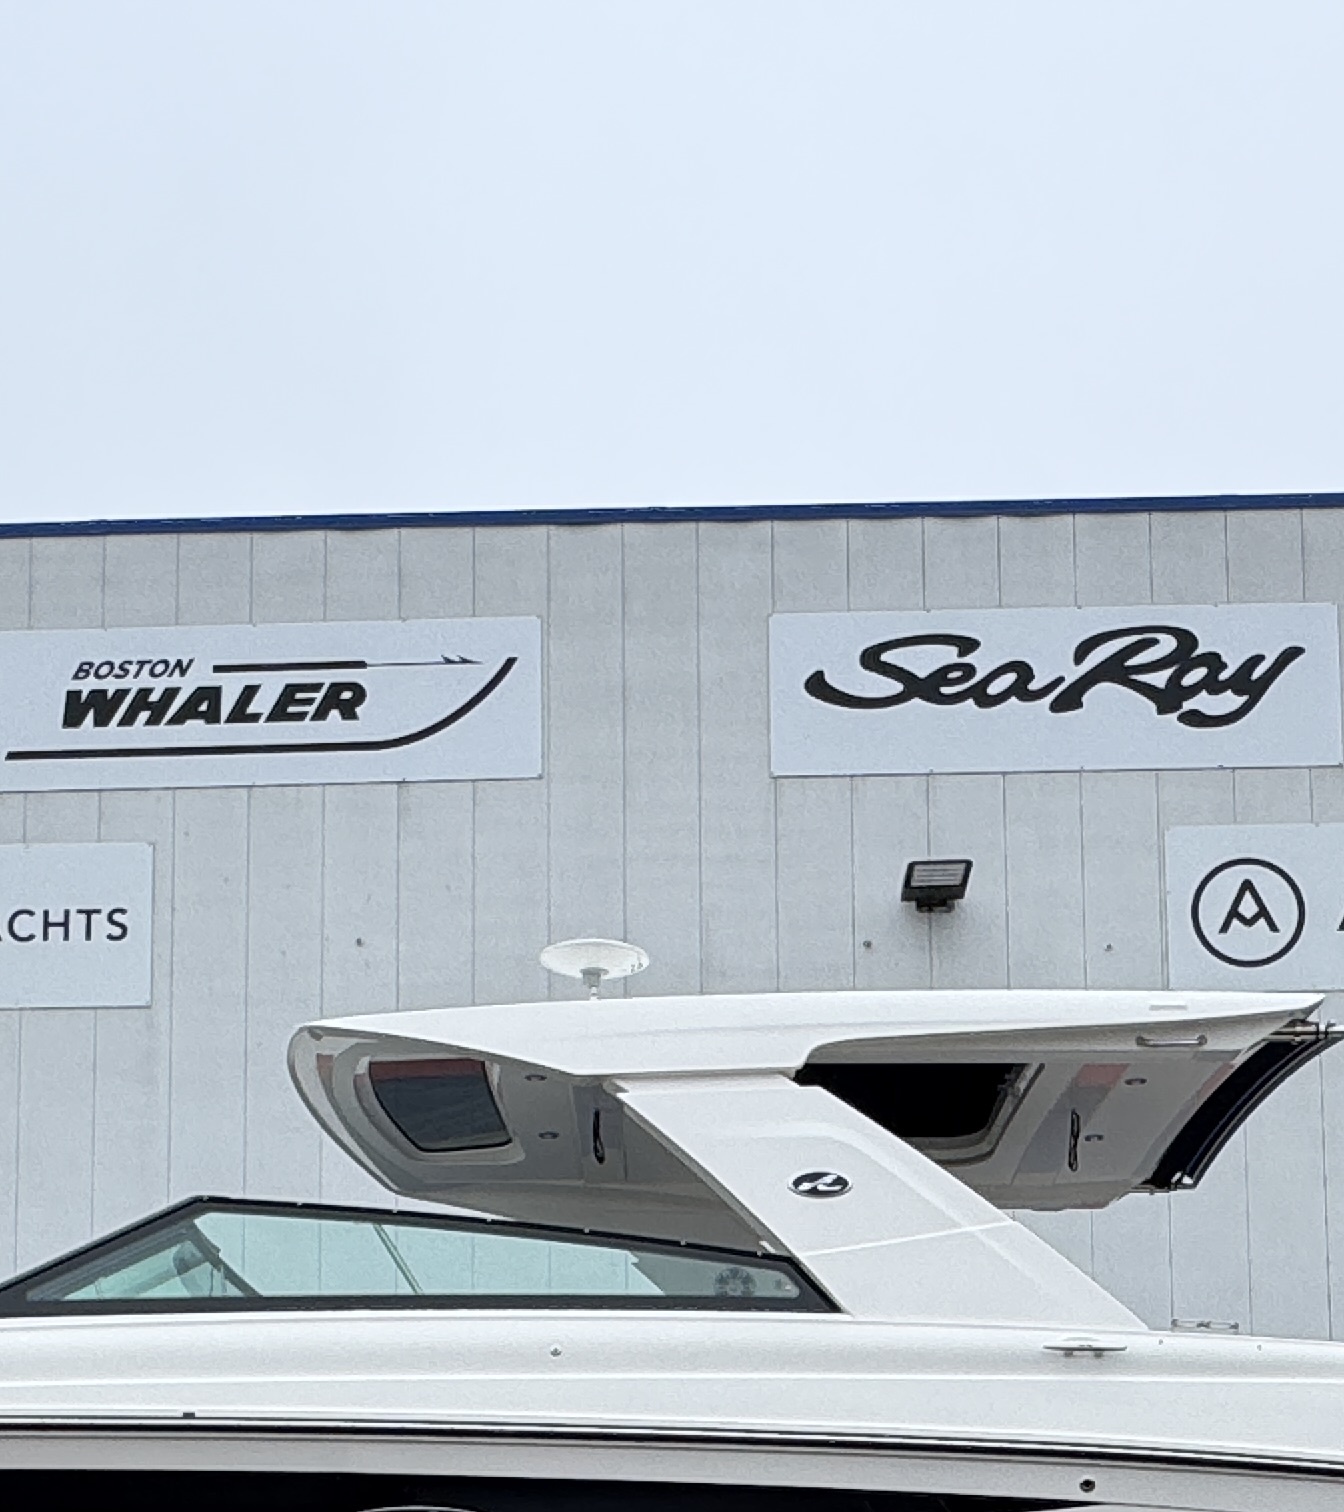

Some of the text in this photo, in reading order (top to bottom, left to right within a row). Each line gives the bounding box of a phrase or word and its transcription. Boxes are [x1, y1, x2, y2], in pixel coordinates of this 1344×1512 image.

[71, 658, 195, 681] BOSTON
[804, 624, 1306, 729] Sea Ray
[61, 681, 369, 730] WHALER
